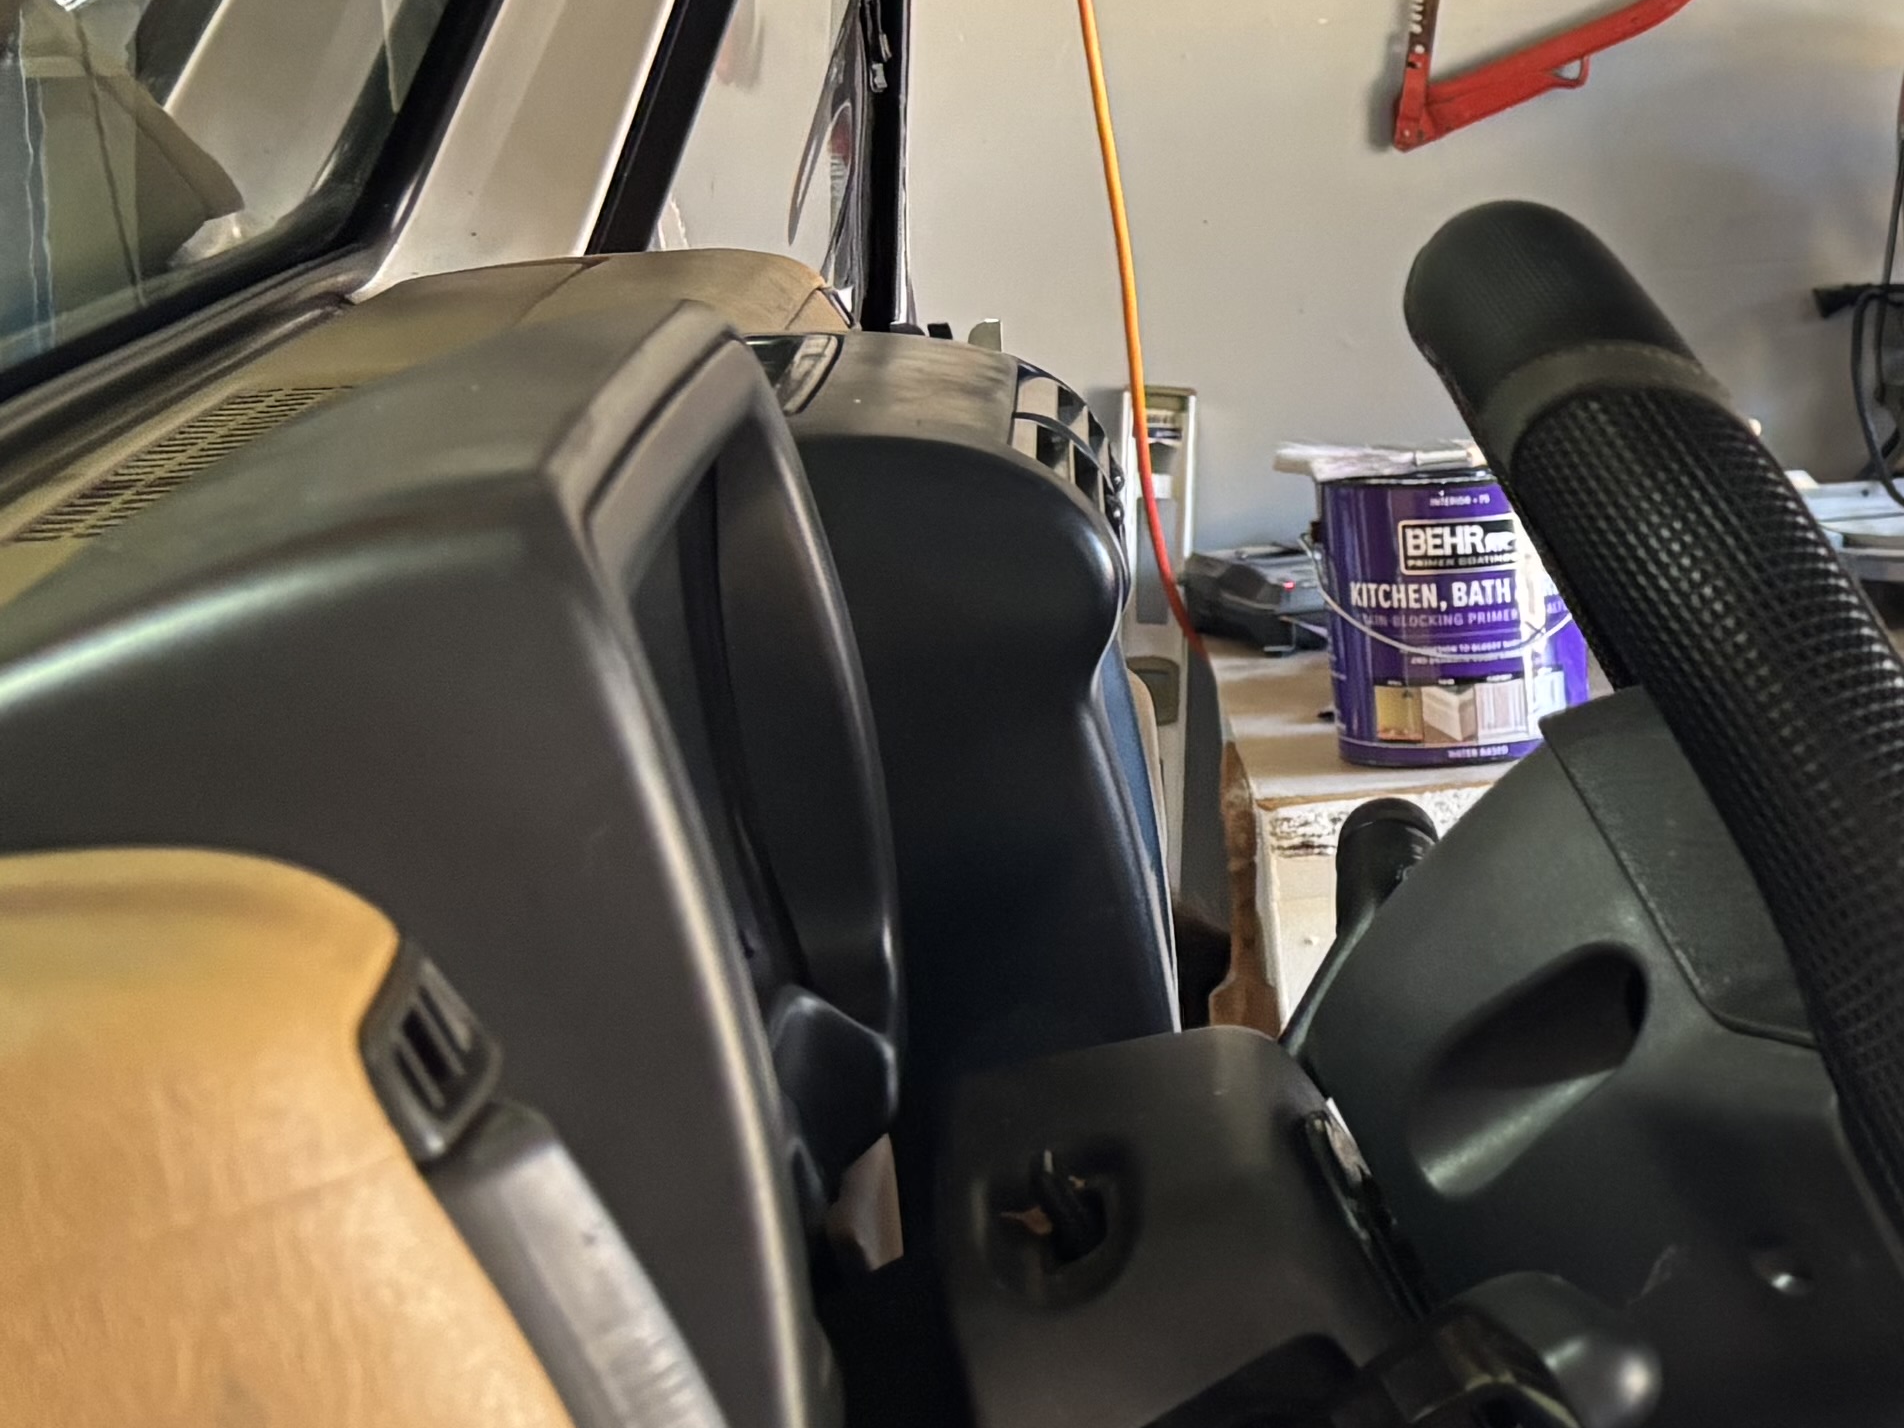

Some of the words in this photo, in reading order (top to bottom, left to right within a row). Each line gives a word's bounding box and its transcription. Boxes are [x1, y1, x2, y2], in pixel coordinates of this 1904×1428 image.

[1404, 525, 1486, 557] BEHR
[1350, 580, 1448, 613] KITCHEN,
[1452, 577, 1512, 606] BATH
